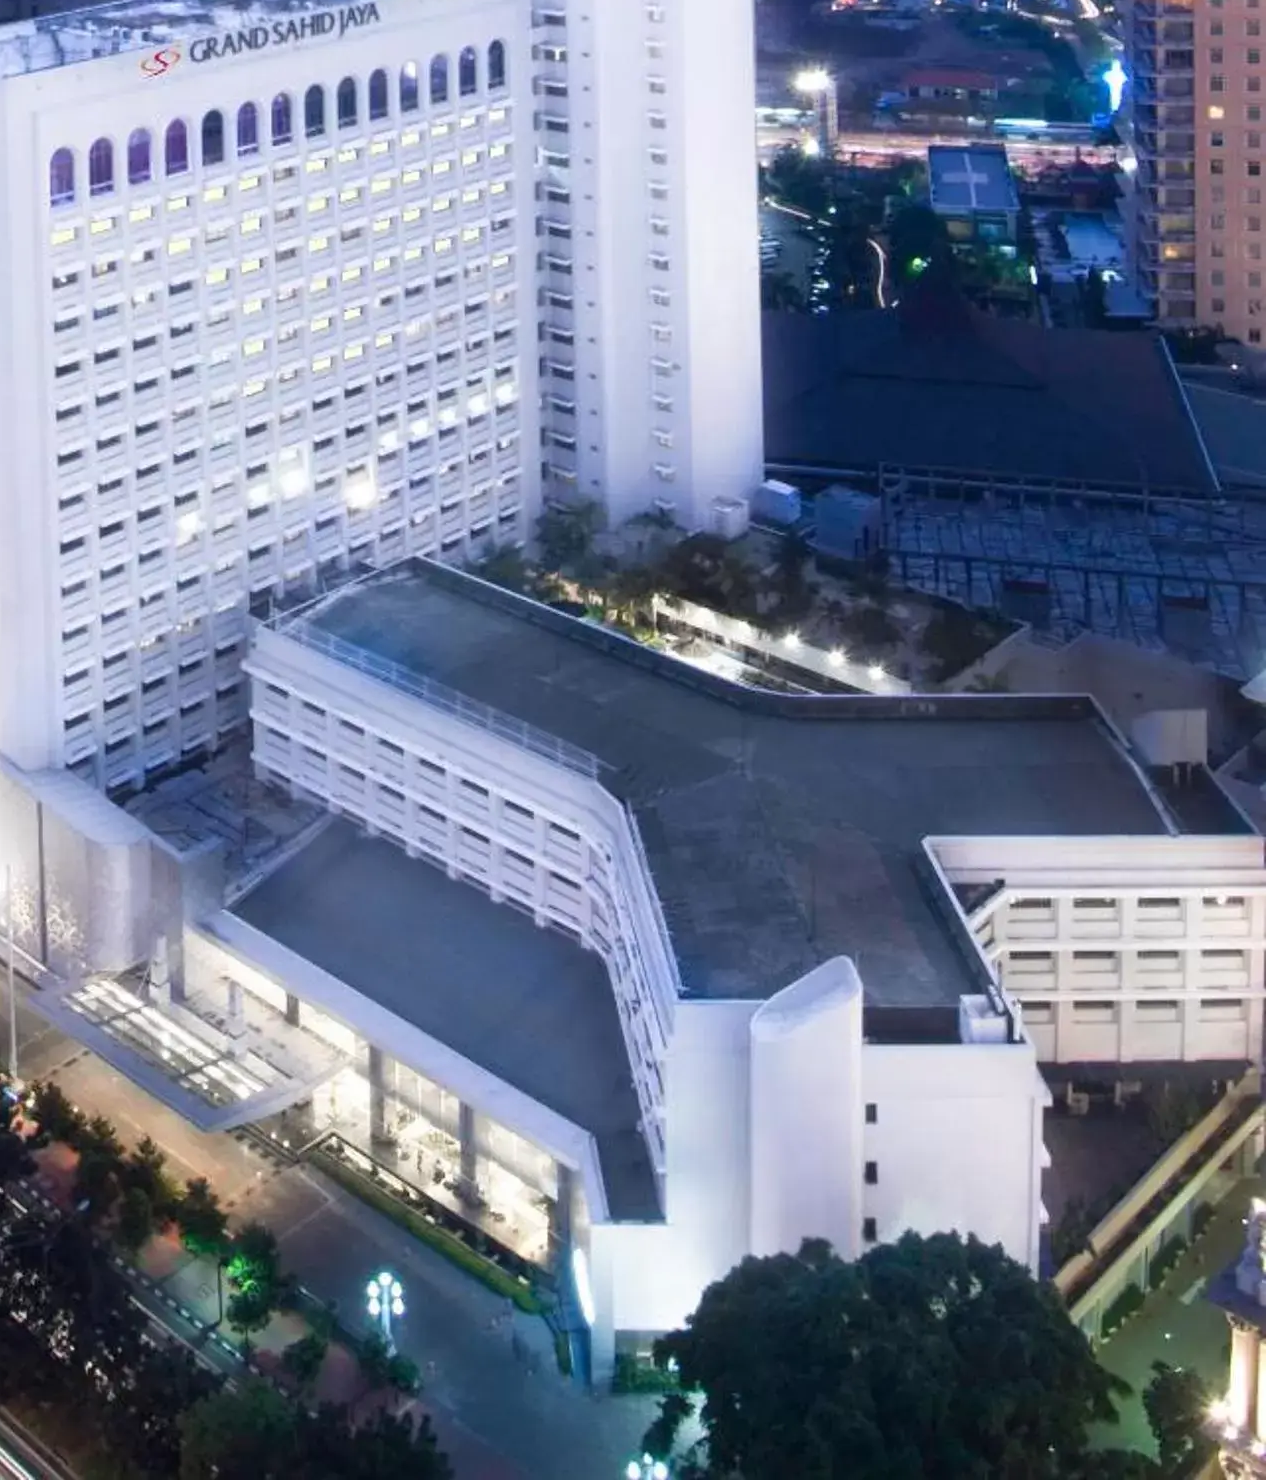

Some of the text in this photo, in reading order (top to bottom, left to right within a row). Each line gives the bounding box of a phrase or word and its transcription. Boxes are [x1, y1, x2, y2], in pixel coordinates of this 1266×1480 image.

[189, 2, 380, 63] GRAND SAHID JAYA
